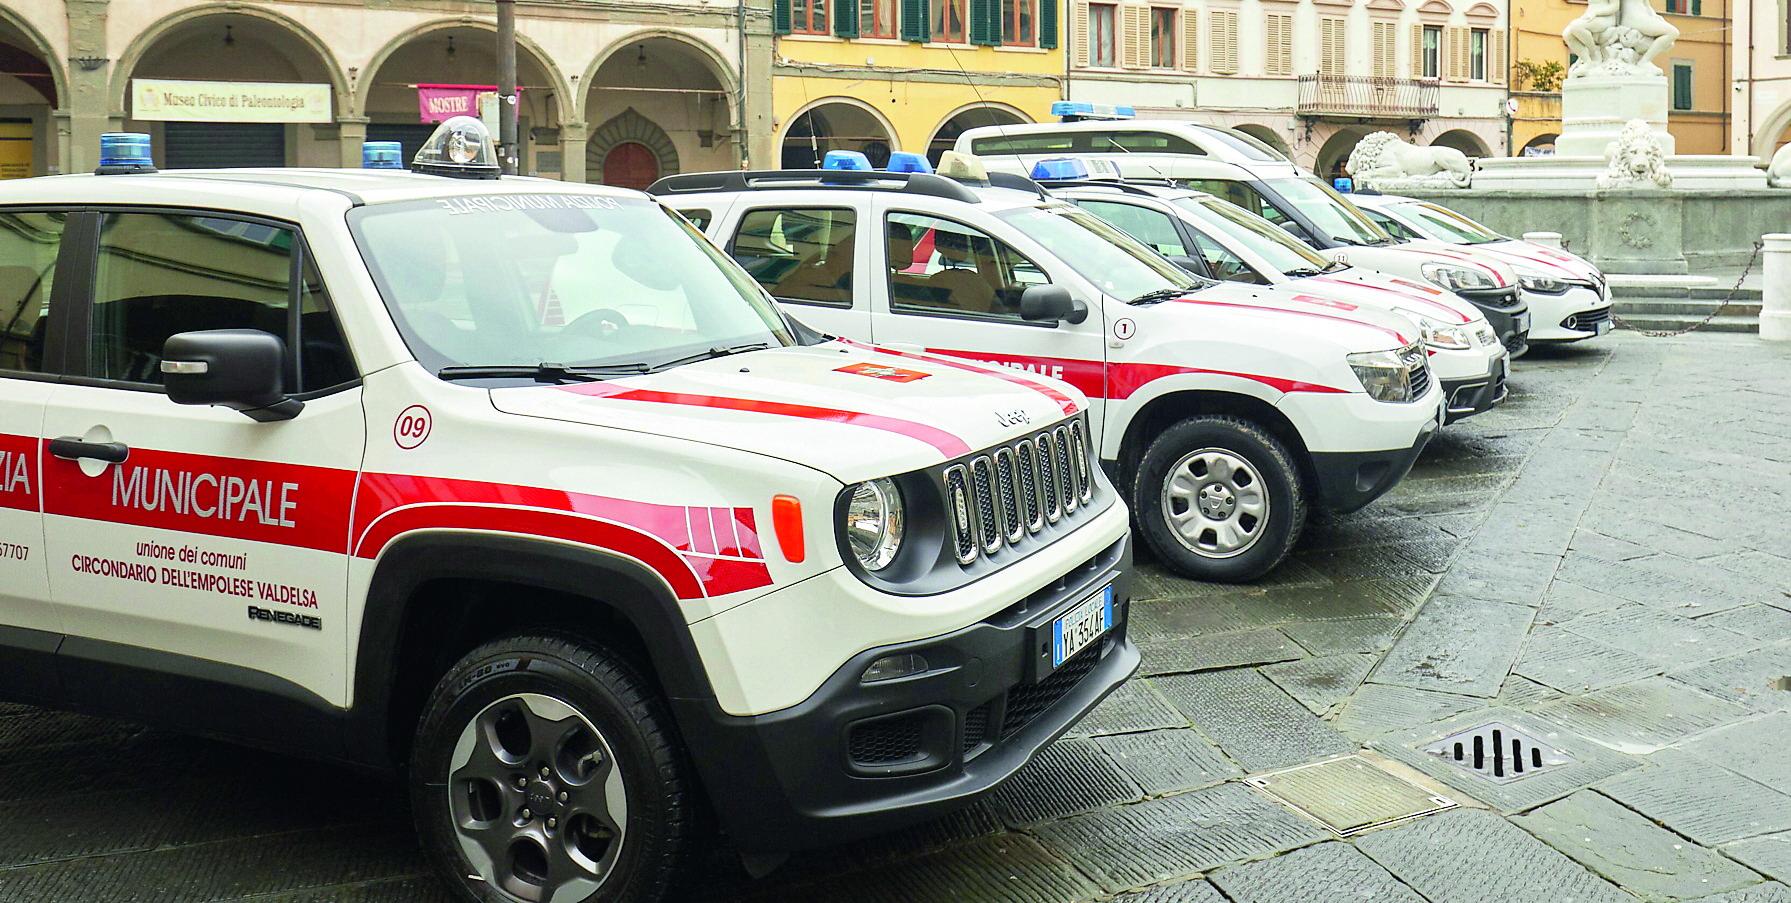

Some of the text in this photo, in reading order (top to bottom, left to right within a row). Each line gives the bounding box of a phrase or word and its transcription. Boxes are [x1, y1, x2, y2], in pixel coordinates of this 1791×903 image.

[163, 92, 305, 111] Museo Civico di Paleontologia
[428, 96, 469, 113] MOSTRE
[400, 415, 426, 438] 09
[112, 463, 299, 528] MUNICIPALE
[136, 540, 247, 571] unione dei comuni
[71, 554, 319, 609] CIRCONDARIO DELL'EMPOLESE VALDELSA
[247, 605, 322, 631] RENEGADE
[1063, 628, 1075, 658] YA
[1078, 606, 1105, 647] 354AF
